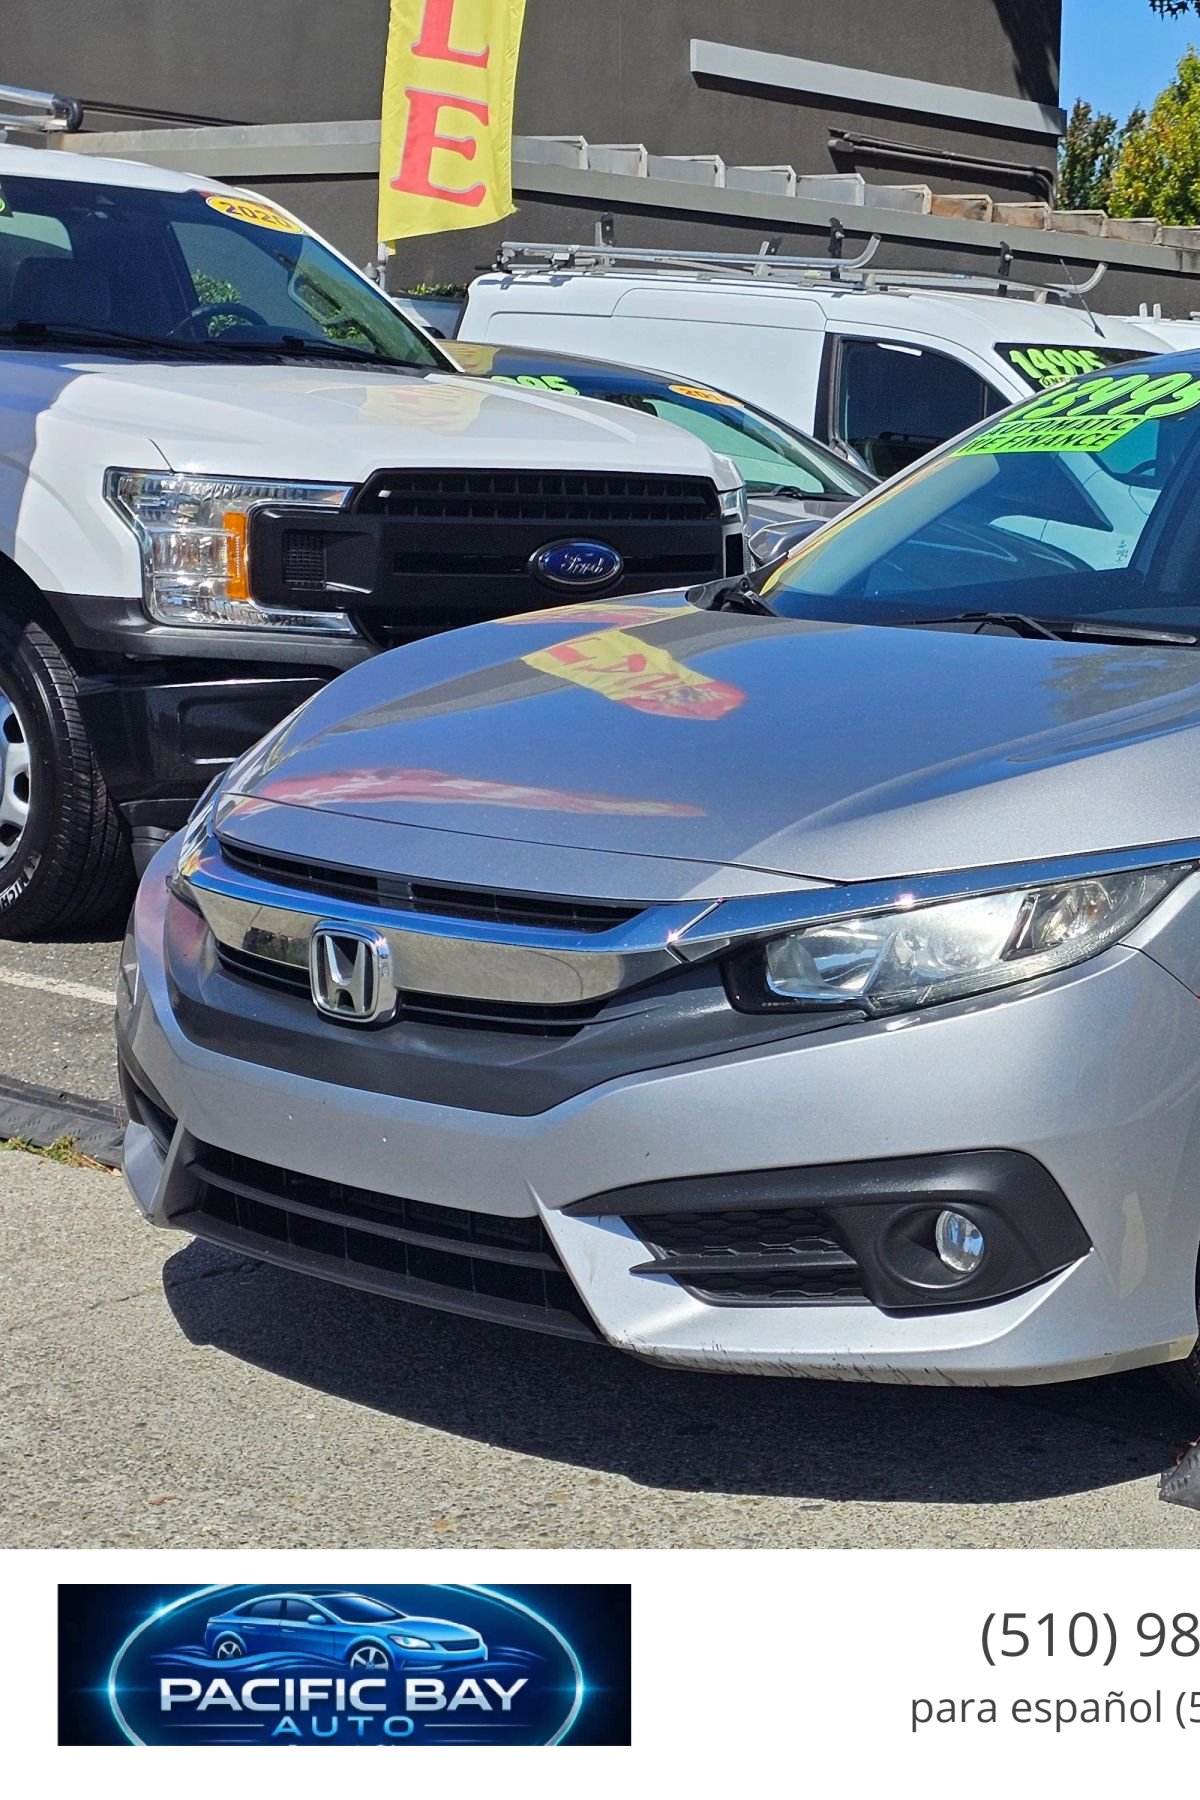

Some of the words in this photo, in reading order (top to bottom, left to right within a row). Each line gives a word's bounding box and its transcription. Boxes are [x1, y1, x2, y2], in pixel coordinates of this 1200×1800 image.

[219, 201, 293, 228] 2020
[989, 416, 1137, 435] AUTOMATIC
[961, 438, 996, 452] WE
[998, 433, 1118, 448] FINANCE
